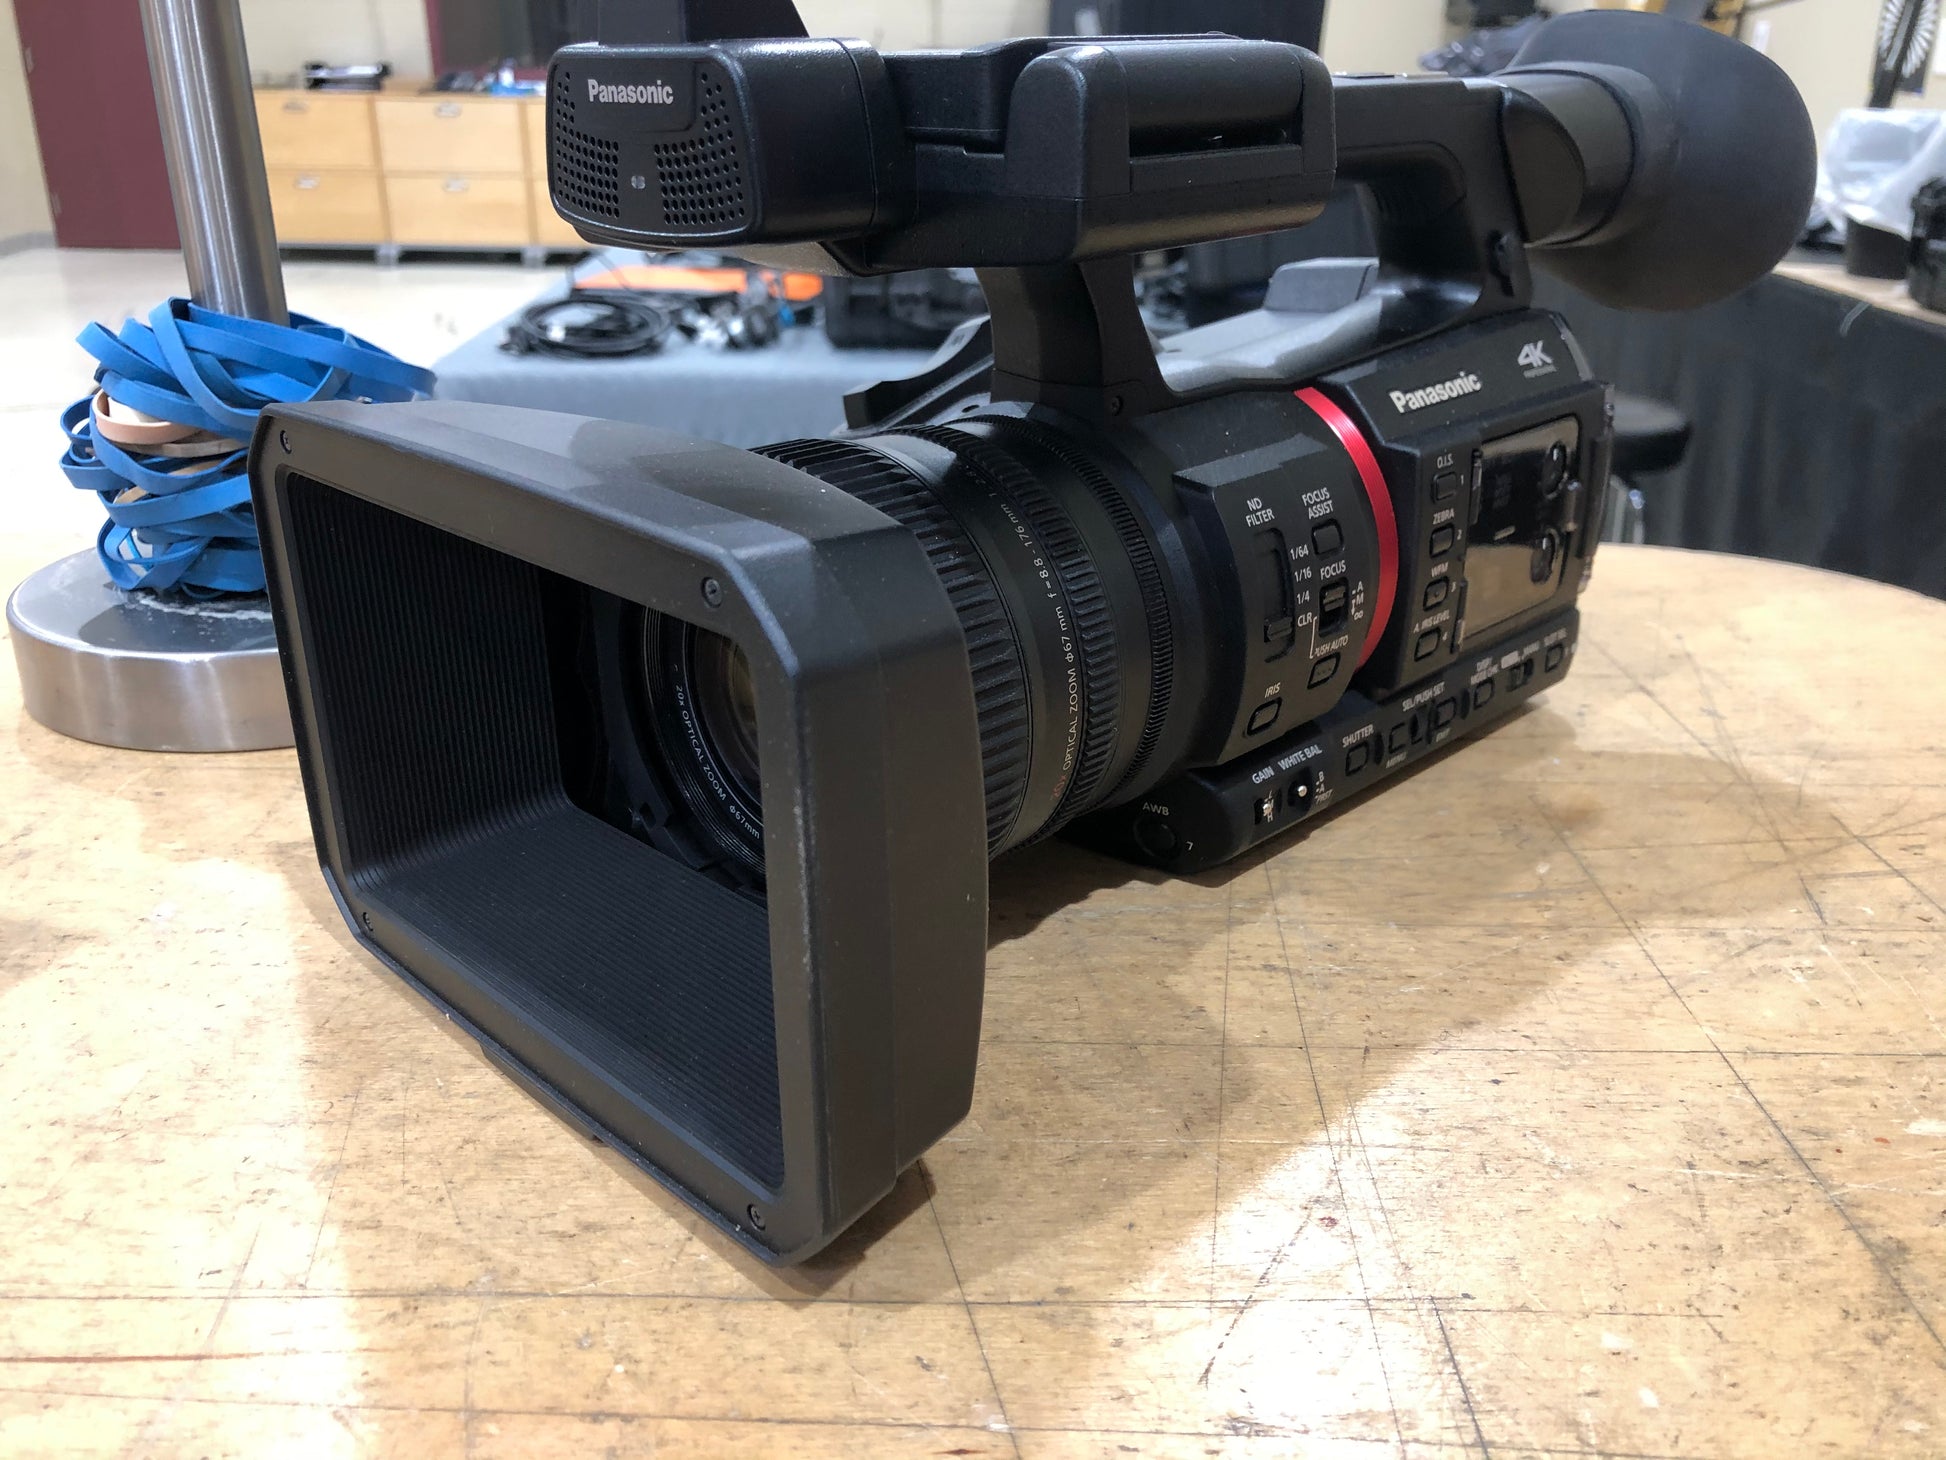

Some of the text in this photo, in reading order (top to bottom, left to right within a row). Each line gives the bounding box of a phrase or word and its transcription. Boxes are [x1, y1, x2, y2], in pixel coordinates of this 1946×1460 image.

[587, 79, 674, 104] Panasonic
[1518, 340, 1553, 367] 4K
[1389, 371, 1482, 414] Panasonic
[1246, 497, 1263, 512] ND
[1301, 487, 1330, 506] FOCUS
[1000, 503, 1019, 524] mm
[1245, 508, 1275, 527] FILTER
[1308, 500, 1334, 519] ASSIST
[1432, 508, 1454, 525] ZEBRA
[1014, 525, 1033, 547] 176
[1290, 544, 1309, 561] 1/64
[1294, 566, 1312, 583] 1/16
[1320, 560, 1347, 580] FOCUS
[1357, 581, 1364, 592] A
[1296, 591, 1310, 605] 1/4
[1356, 593, 1364, 606] M
[1055, 606, 1068, 631] mm
[1297, 612, 1313, 628] CLR
[1330, 634, 1349, 650] AUTO
[1067, 667, 1078, 713] ZOOM
[1265, 682, 1281, 698] IRIS
[675, 684, 685, 706] 20x
[682, 710, 704, 763] OPTICAL
[703, 764, 727, 801] ZOOM
[1062, 716, 1078, 771] OPTICAL
[1342, 724, 1375, 748] SHUTTER
[1252, 744, 1323, 784] GAIN WHITE BAL
[1318, 771, 1325, 782] B
[1319, 783, 1325, 793] A
[1142, 802, 1170, 816] AWB
[1186, 841, 1194, 851] 7
